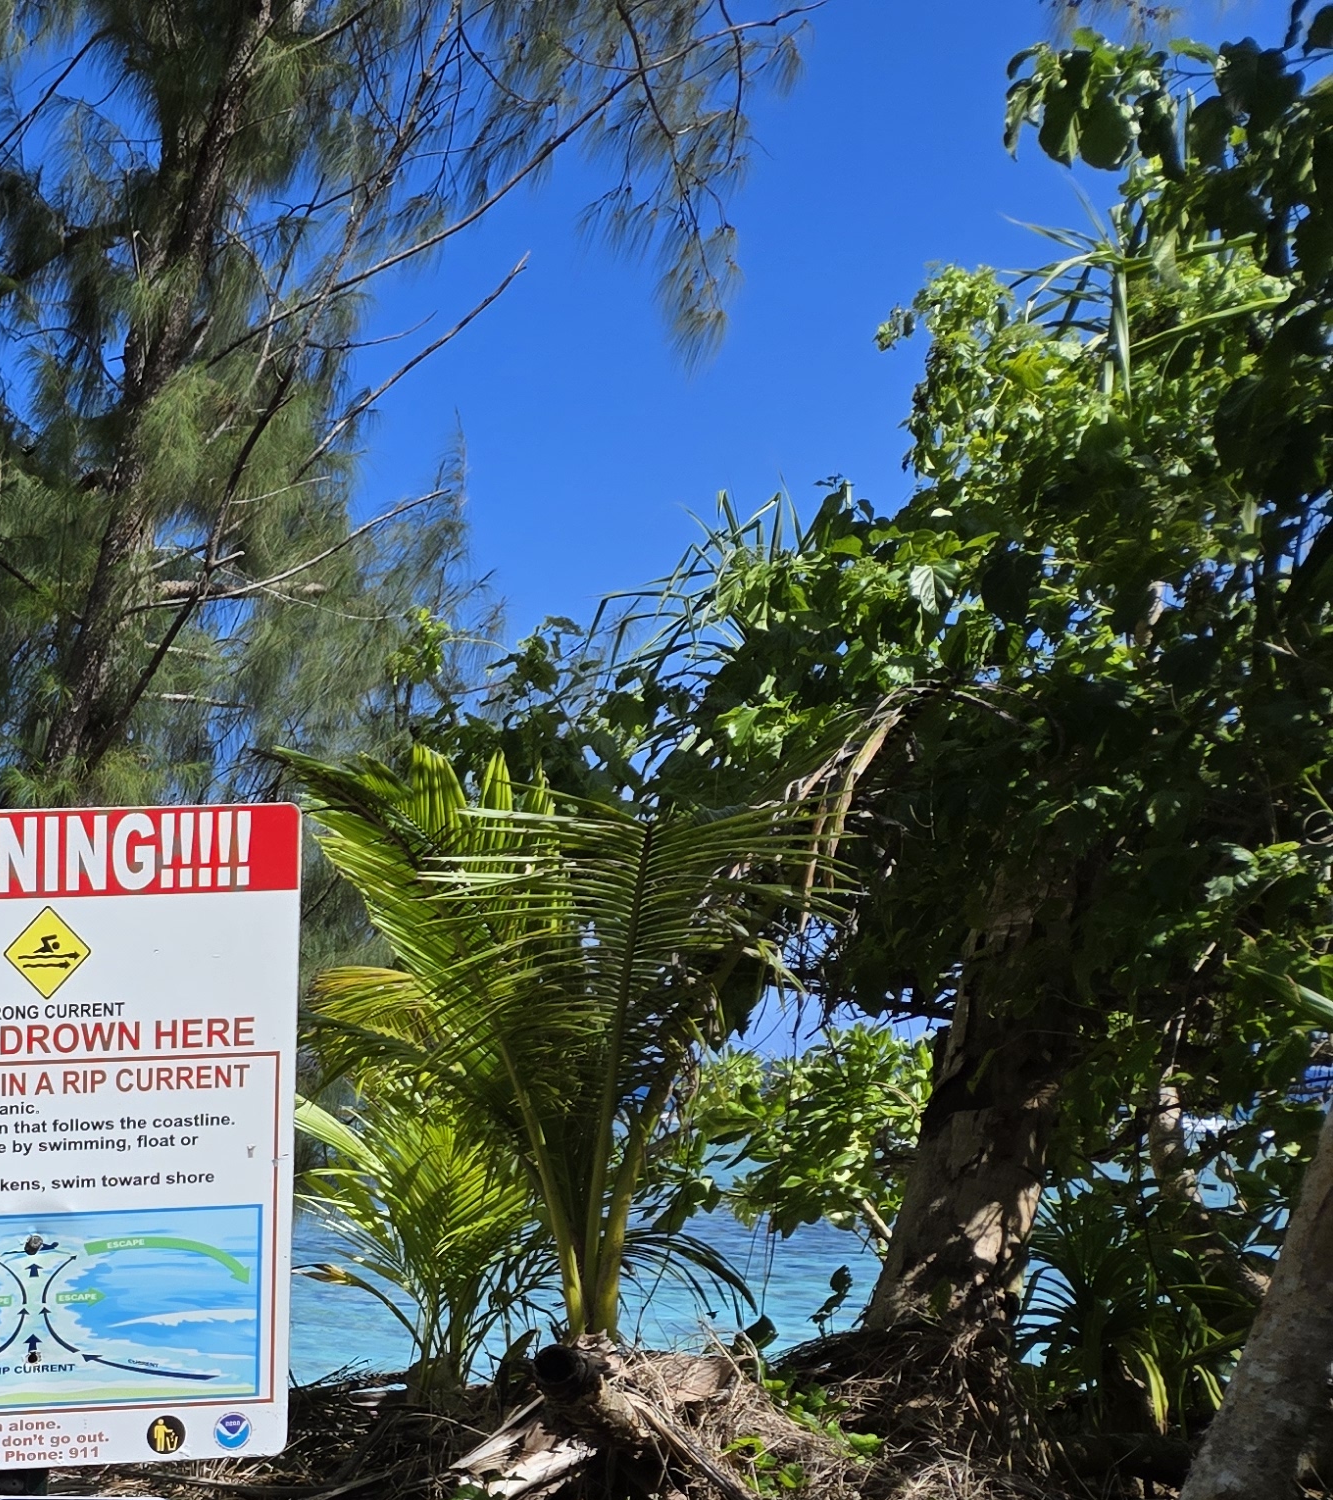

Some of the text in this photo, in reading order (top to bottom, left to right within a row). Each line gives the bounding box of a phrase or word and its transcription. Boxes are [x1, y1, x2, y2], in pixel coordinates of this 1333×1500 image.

[45, 1002, 125, 1018] CURRENT
[0, 1021, 140, 1055] DROWN
[155, 1017, 255, 1049] HERE
[1, 1072, 26, 1096] IN
[35, 1072, 55, 1095] A
[63, 1070, 107, 1094] RIP
[116, 1064, 250, 1092] CURRENT
[14, 1120, 47, 1134] that
[52, 1118, 114, 1133] follows
[120, 1116, 147, 1130] the
[152, 1113, 235, 1129] coastline.
[12, 1140, 32, 1155] by
[38, 1136, 131, 1153] swimming,
[137, 1134, 175, 1148] float
[180, 1136, 198, 1146] or
[51, 1175, 96, 1190] swim
[101, 1172, 161, 1187] toward
[166, 1171, 215, 1185] shore
[106, 1239, 146, 1249] ESCAPE
[58, 1293, 97, 1302] ESCAPE
[14, 1363, 75, 1375] CURRENT
[127, 1358, 159, 1368] CURRENT
[8, 1418, 61, 1432] alone.
[49, 1434, 70, 1448] go
[76, 1430, 109, 1444] out.
[4, 1449, 63, 1462] Phone:
[69, 1446, 99, 1459] 911
